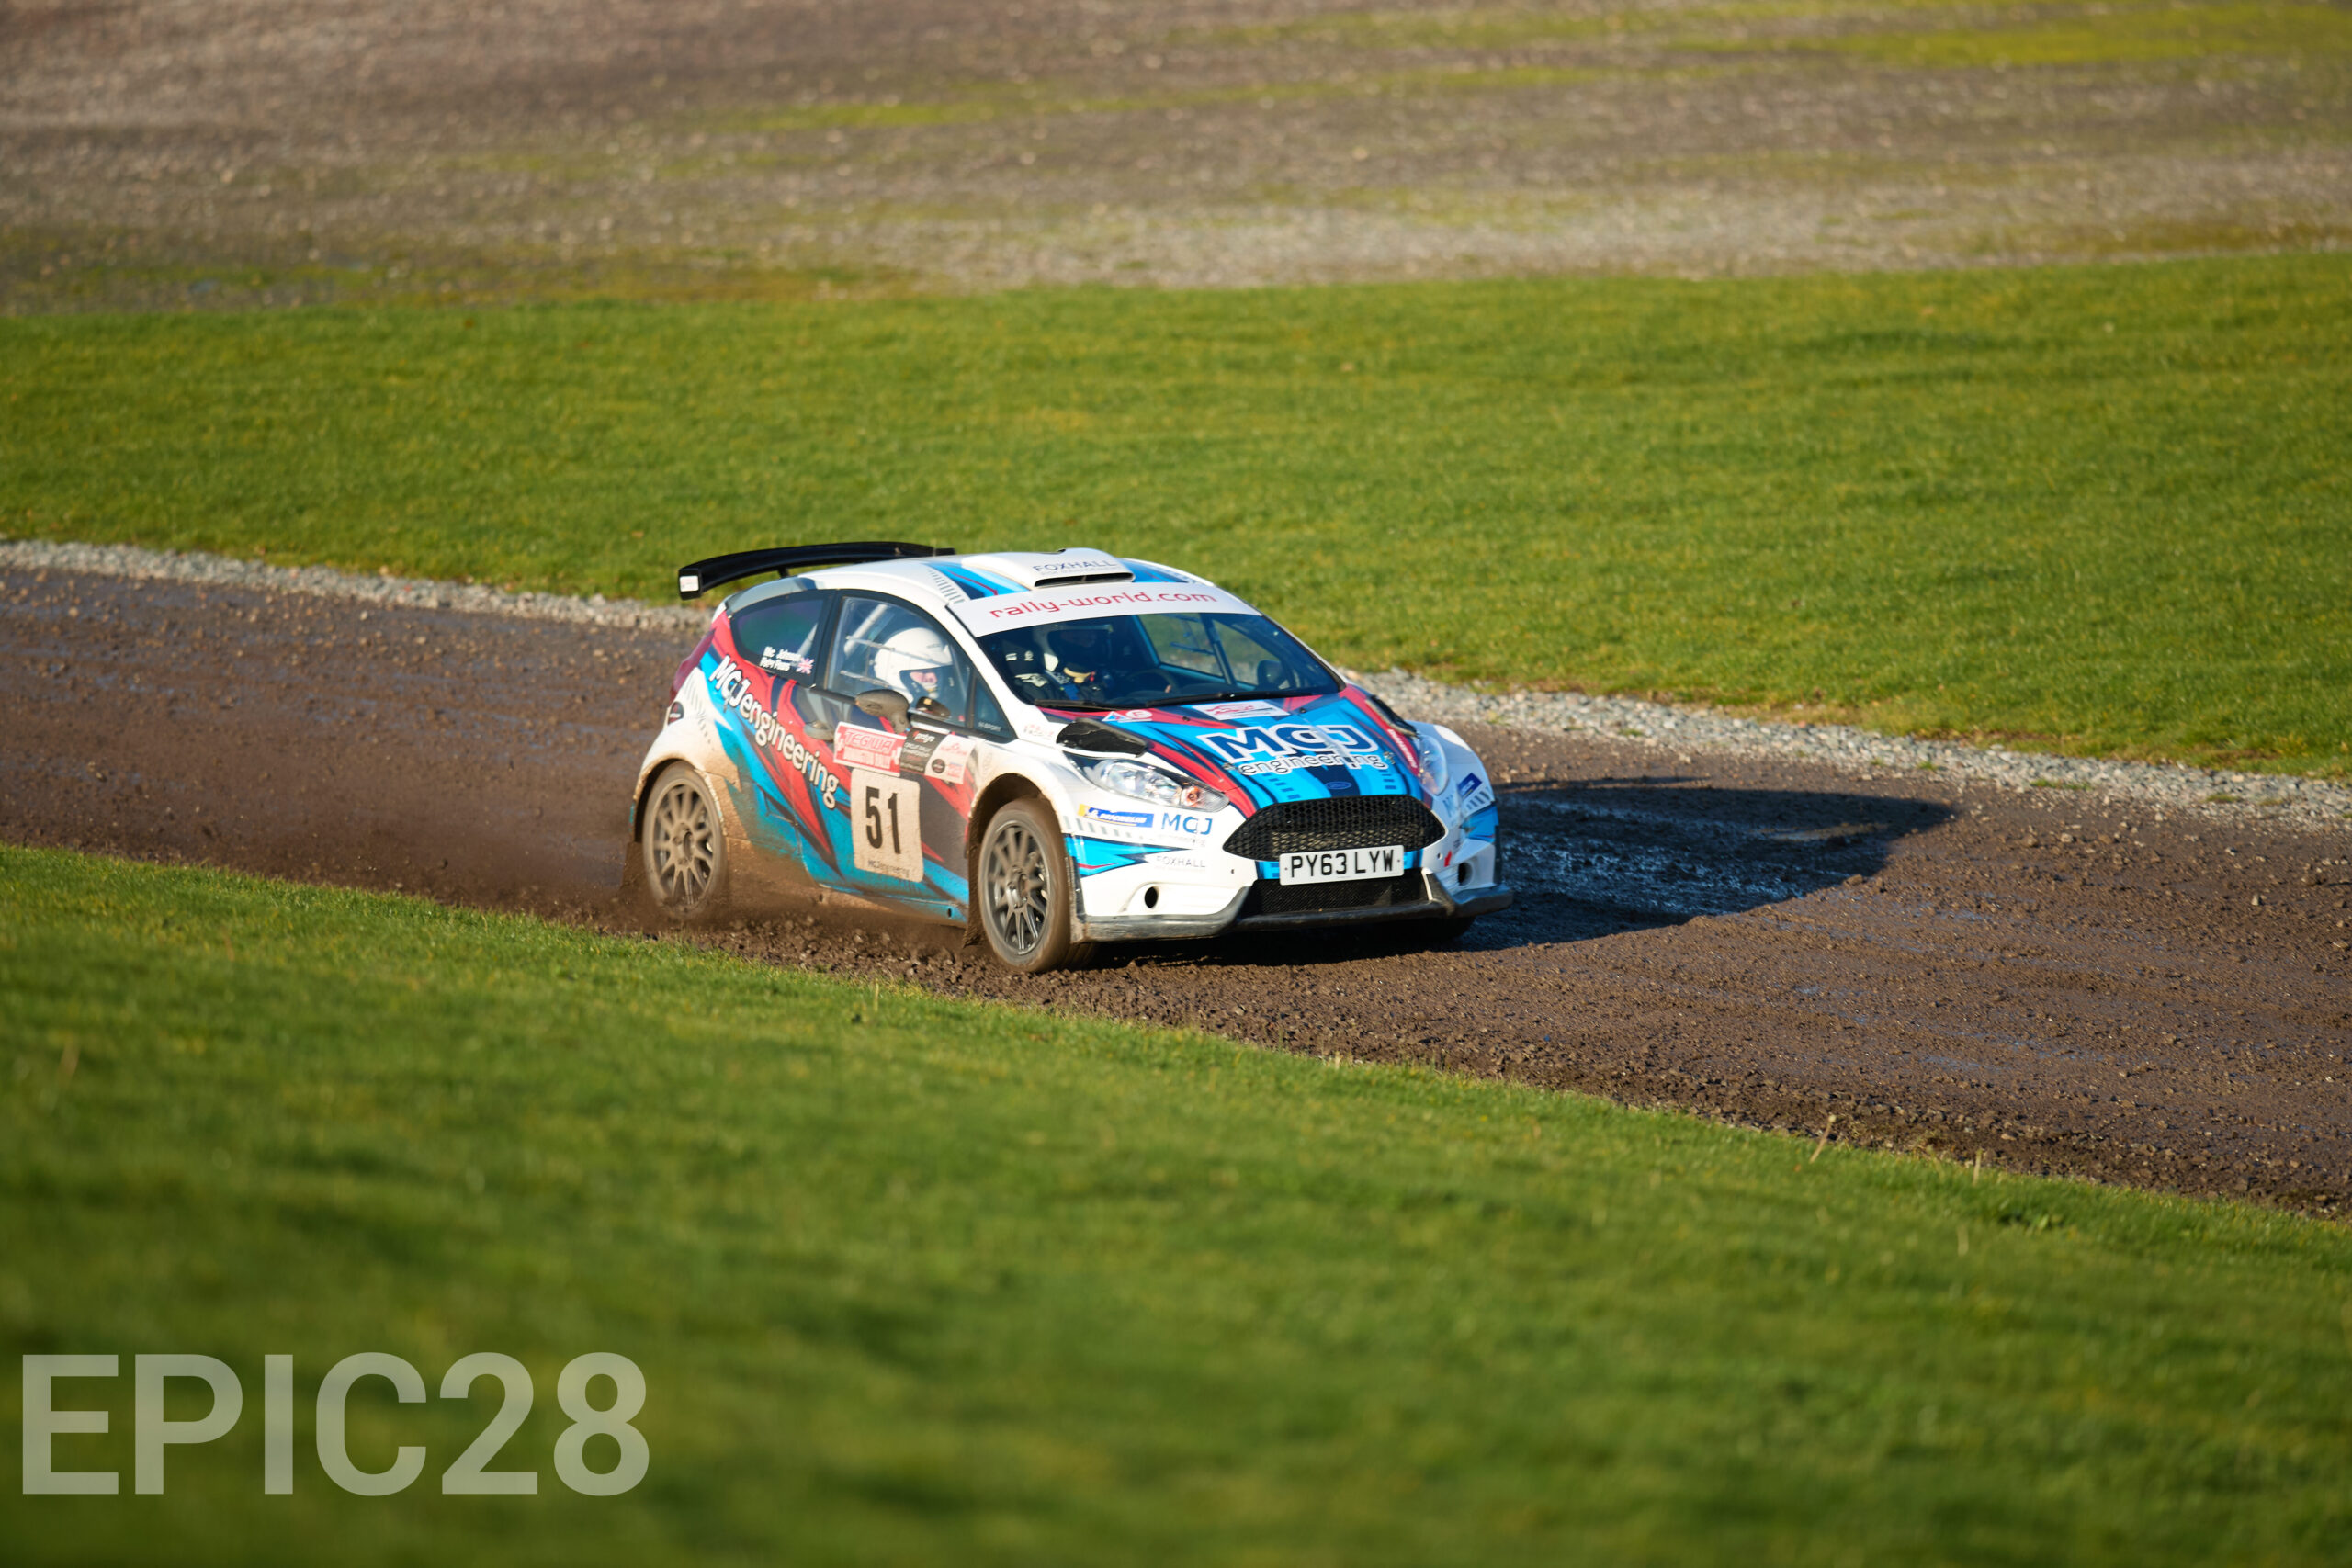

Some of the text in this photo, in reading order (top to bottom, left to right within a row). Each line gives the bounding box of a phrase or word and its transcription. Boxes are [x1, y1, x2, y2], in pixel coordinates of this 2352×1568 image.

[1033, 559, 1118, 571] FOXHALL
[989, 591, 1217, 618] rally-world.com
[1197, 724, 1379, 763] MCJ
[1239, 753, 1386, 776] engineering
[865, 785, 901, 855] 51
[1157, 855, 1207, 868] FOXHALL
[1291, 849, 1394, 878] PY63 LYW
